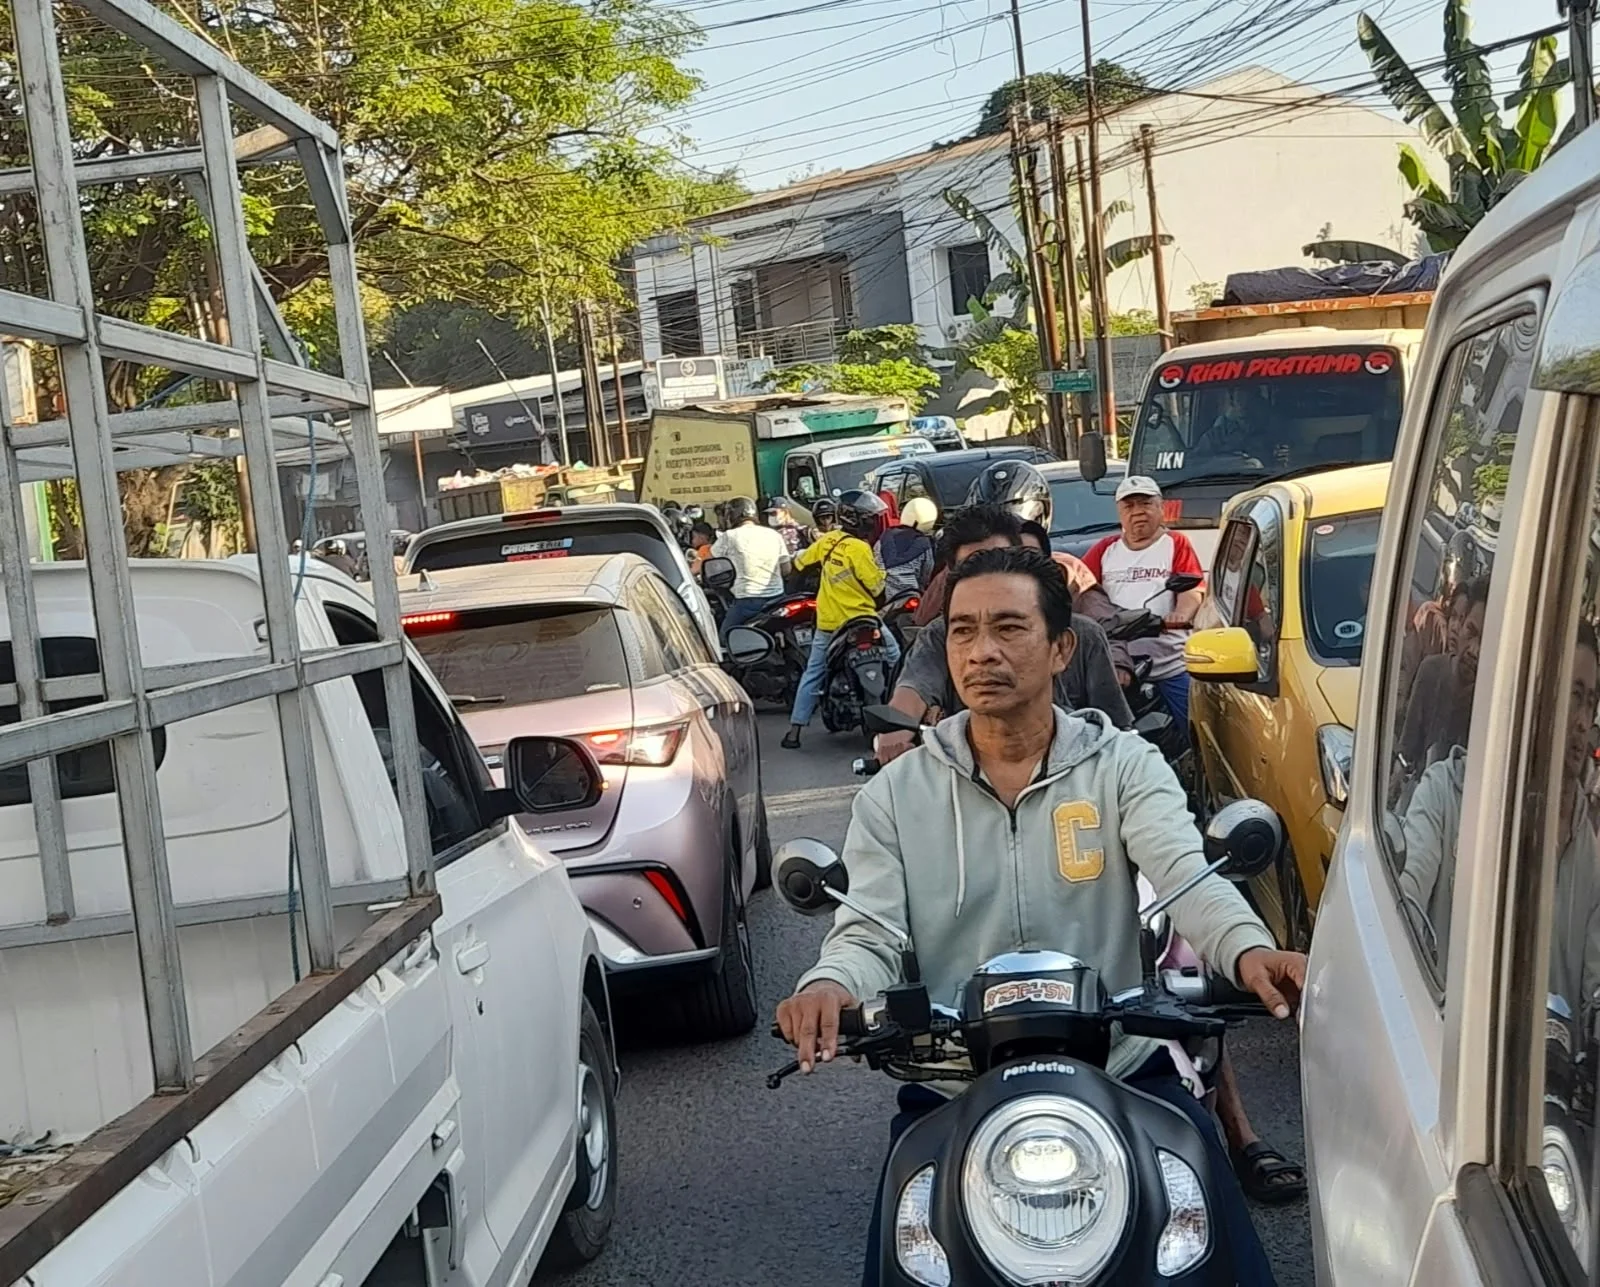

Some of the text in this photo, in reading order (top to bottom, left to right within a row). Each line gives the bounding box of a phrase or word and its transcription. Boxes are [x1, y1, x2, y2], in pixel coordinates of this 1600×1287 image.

[1246, 352, 1362, 377] PRATAMA
[1156, 451, 1184, 470] IKN
[1132, 567, 1166, 580] DENIM
[1052, 800, 1105, 883] C
